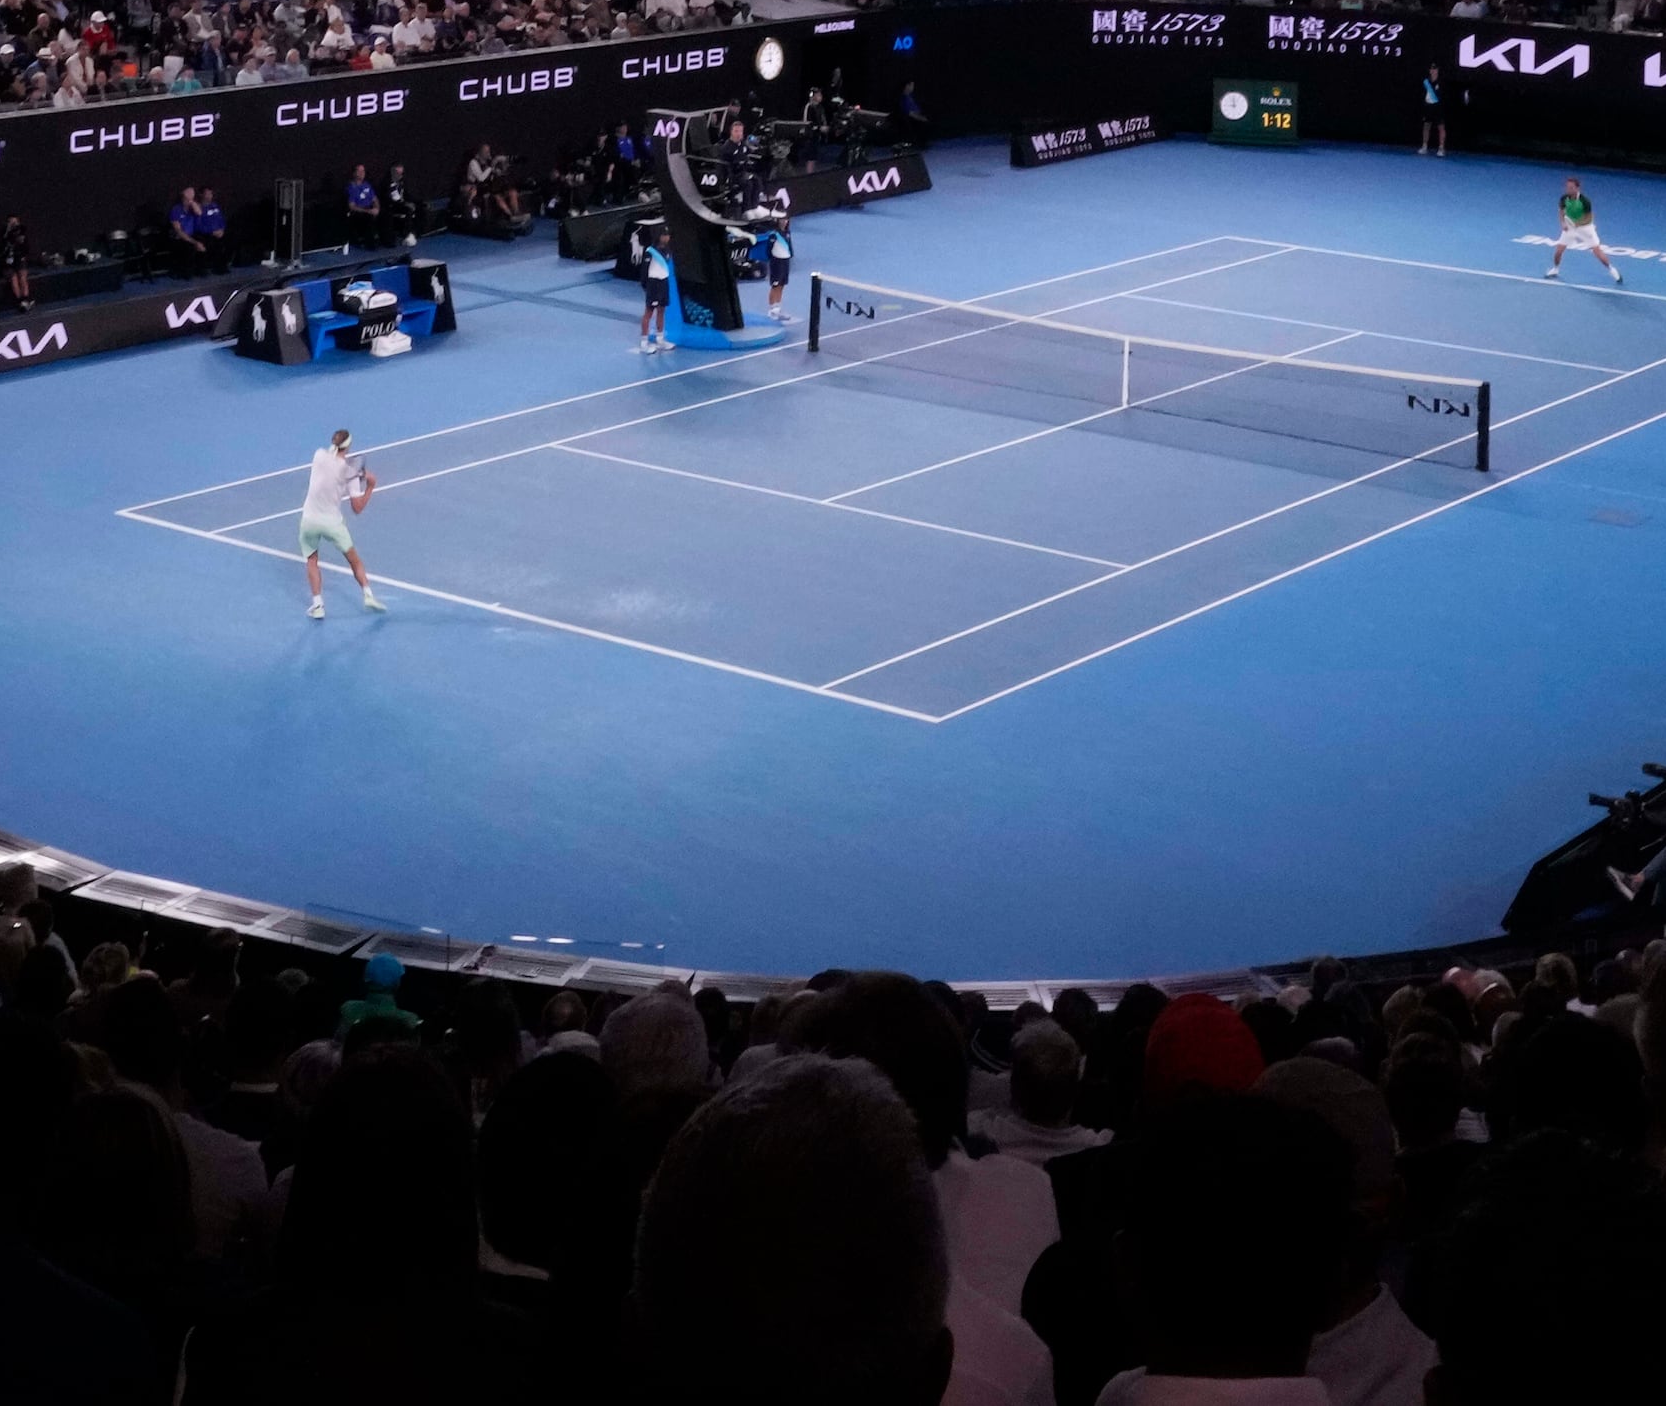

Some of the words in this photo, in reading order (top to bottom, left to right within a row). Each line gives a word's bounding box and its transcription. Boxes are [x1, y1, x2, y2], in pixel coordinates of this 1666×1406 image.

[893, 36, 913, 50] AO
[1091, 34, 1170, 45] GUOJIAO
[1183, 36, 1225, 47] 1573
[1267, 40, 1347, 54] GUOJIAO
[1361, 45, 1403, 58] 1573
[1459, 33, 1591, 78] KIA
[1260, 97, 1293, 106] ROLEX
[653, 119, 680, 139] AO
[1261, 112, 1292, 129] 1:12
[701, 174, 718, 187] AO
[847, 167, 902, 195] KIA
[361, 321, 395, 339] POLO
